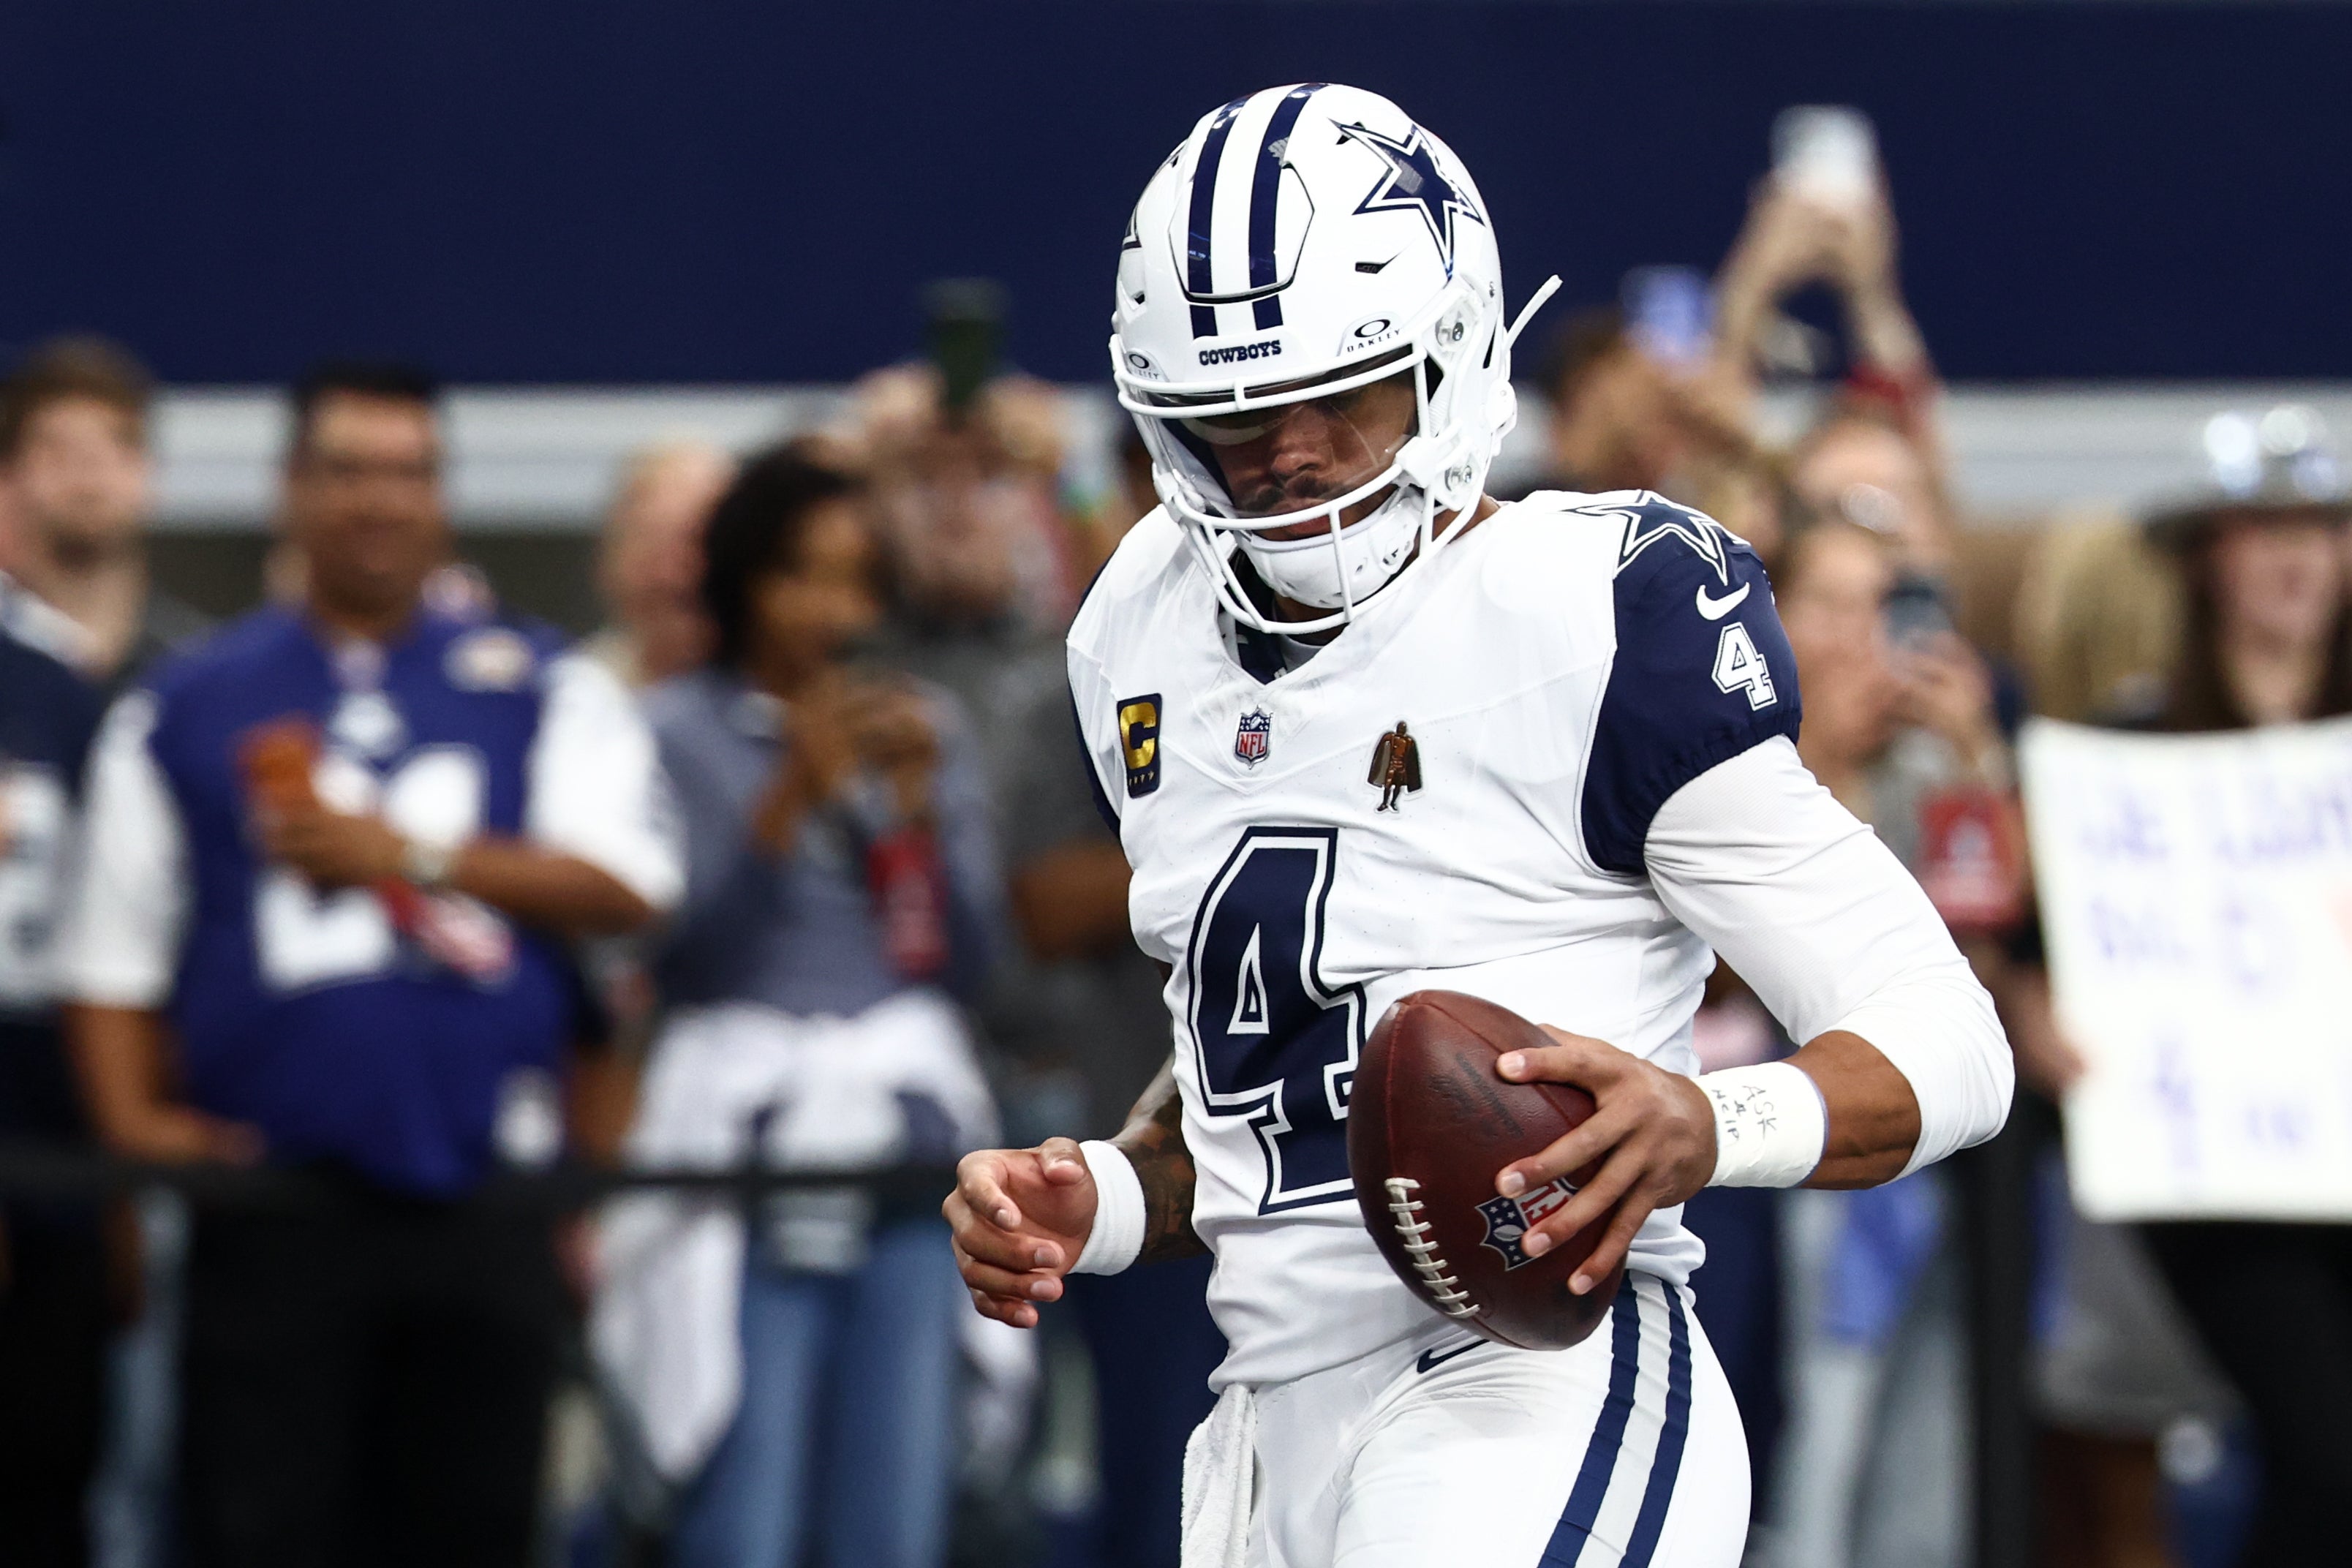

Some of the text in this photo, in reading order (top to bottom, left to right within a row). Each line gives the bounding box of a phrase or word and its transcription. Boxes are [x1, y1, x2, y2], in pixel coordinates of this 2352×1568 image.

[1199, 339, 1281, 366] COWBOYS
[1346, 328, 1400, 353] OAKLEY
[1711, 622, 1778, 711] 4
[1120, 702, 1157, 769] C
[1239, 733, 1265, 757] NFL
[1187, 826, 1366, 1216] 4
[1742, 1085, 1777, 1141] ASK
